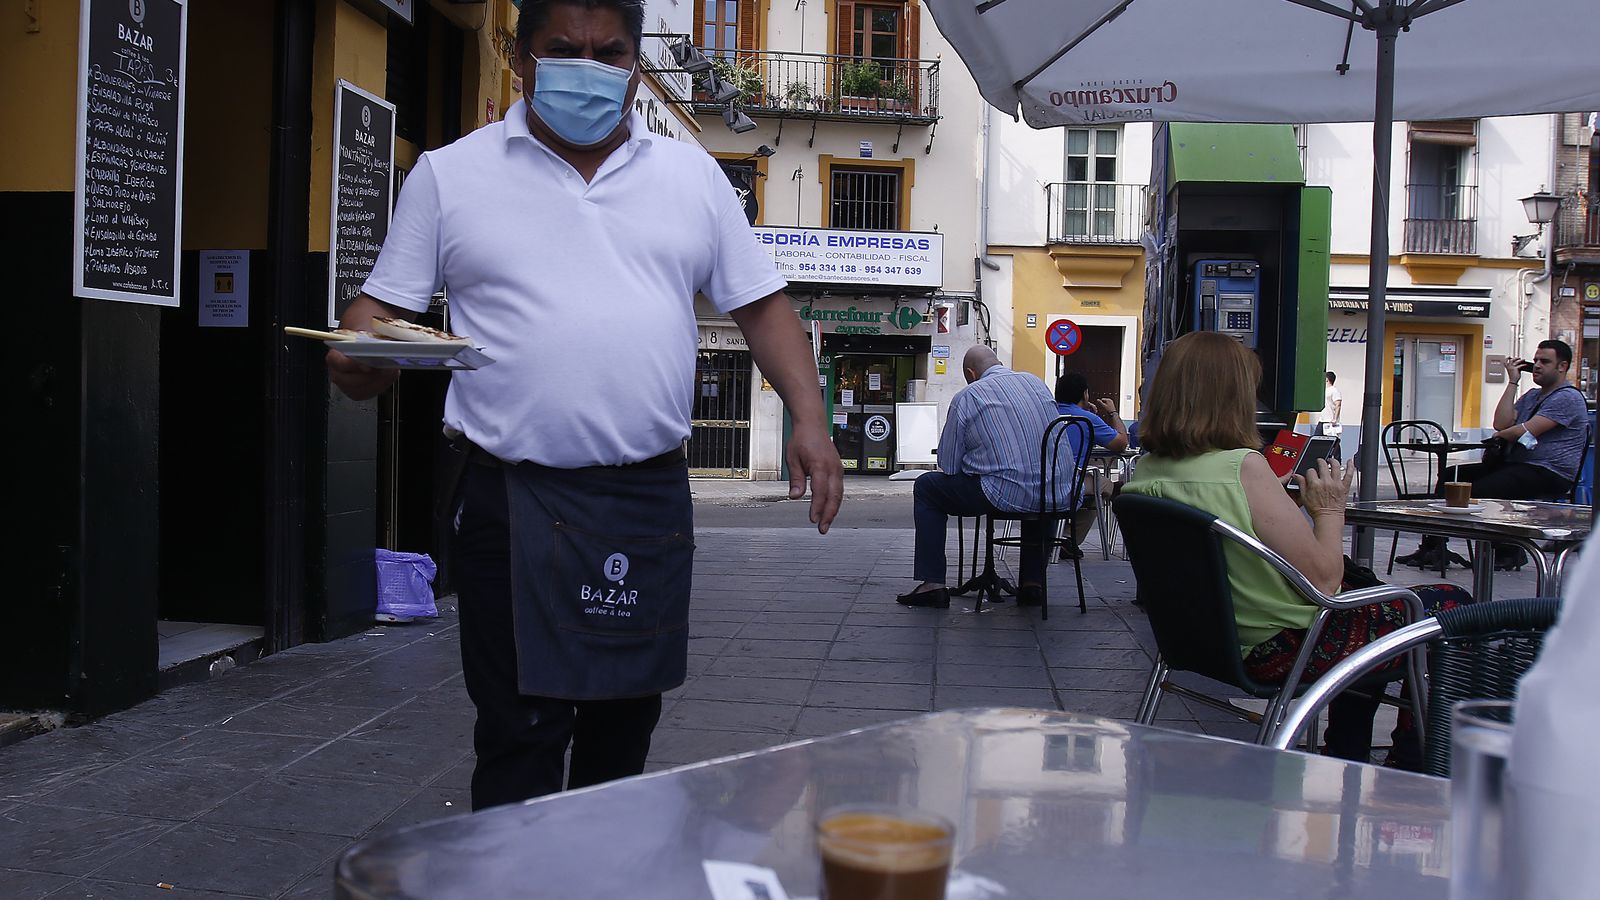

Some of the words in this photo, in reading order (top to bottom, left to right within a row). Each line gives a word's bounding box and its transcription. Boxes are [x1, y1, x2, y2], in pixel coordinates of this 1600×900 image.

[118, 23, 153, 52] BAZAR
[354, 129, 376, 147] BAZAR
[90, 180, 113, 197] QUESO
[131, 191, 138, 200] de
[90, 211, 109, 224] LOMO
[827, 235, 930, 250] EMPRESAS
[775, 250, 817, 259] LABORAL
[825, 251, 891, 262] CONTABILIDAD
[899, 254, 930, 263] FISCAL
[799, 263, 816, 272] 954
[819, 263, 836, 272] 334
[840, 264, 857, 273] 138
[865, 265, 882, 274] 954
[885, 266, 901, 275] 347
[905, 267, 922, 275] 639
[1328, 300, 1360, 309] TABERNA
[1457, 304, 1485, 312] Cruzcampo
[800, 305, 883, 324] Carrefour
[834, 324, 881, 335] express
[710, 331, 718, 344] 8
[610, 559, 622, 576] B
[581, 585, 638, 605] BAZAR
[584, 606, 607, 615] coffee
